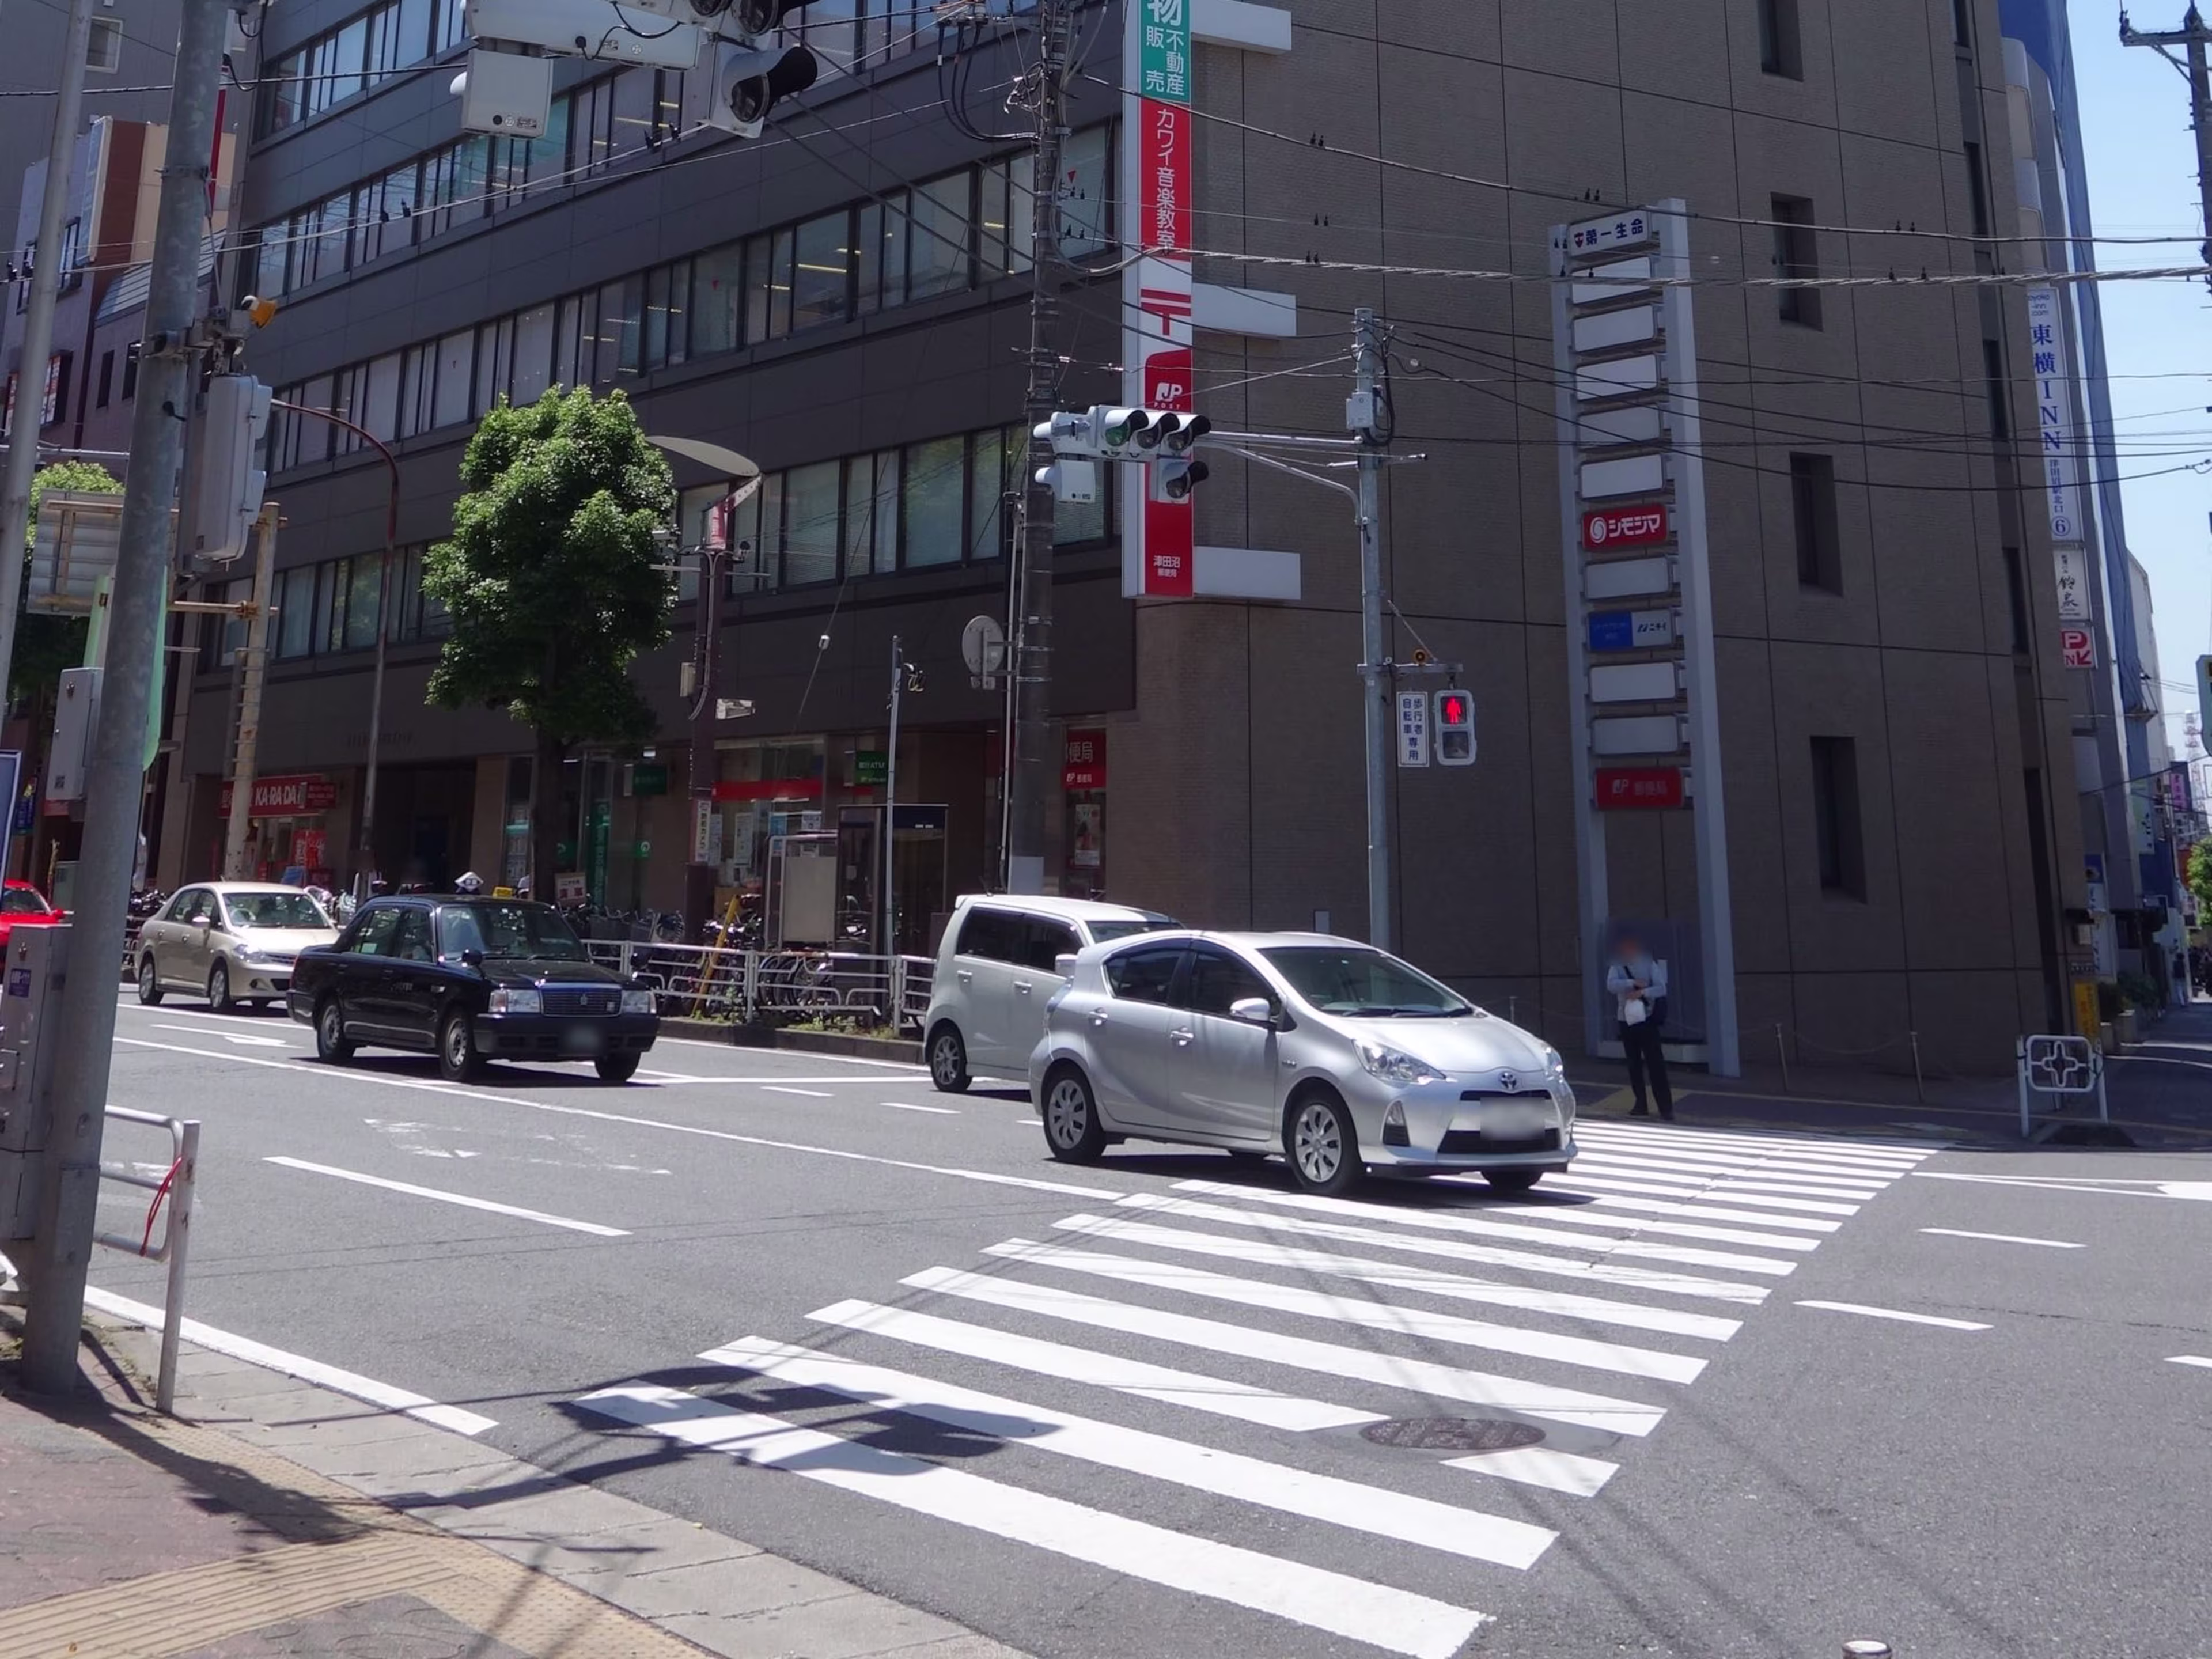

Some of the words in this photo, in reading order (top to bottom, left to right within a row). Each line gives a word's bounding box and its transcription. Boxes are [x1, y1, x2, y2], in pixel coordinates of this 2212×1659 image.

[1146, 25, 1165, 93] 販売
[1166, 29, 1185, 96] 不動産
[1156, 108, 1176, 250] カワイ音楽教室
[1585, 218, 1643, 246] 第一生命
[1154, 382, 1183, 402] JP
[1608, 514, 1661, 538] シモジマ
[1153, 555, 1181, 569] 津田沼
[1402, 698, 1412, 734] 自転車
[1066, 741, 1093, 763] 便局
